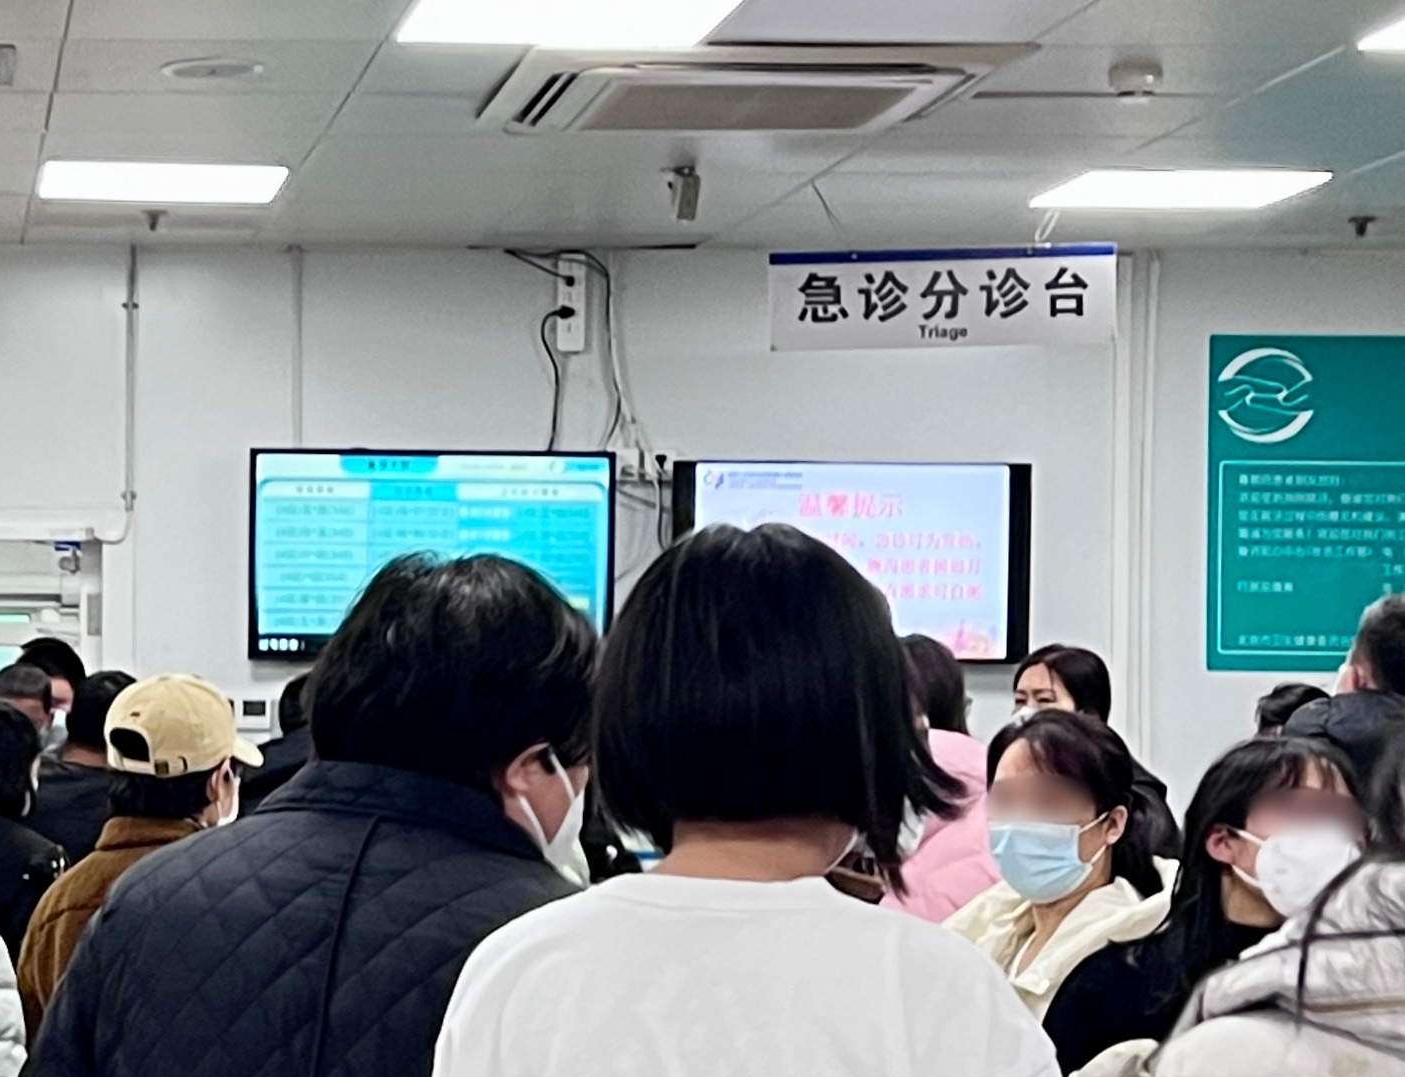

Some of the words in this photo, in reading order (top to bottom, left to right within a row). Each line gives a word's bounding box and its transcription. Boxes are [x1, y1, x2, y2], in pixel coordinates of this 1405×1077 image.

[797, 267, 1090, 324] 急诊分诊台
[918, 323, 969, 342] Triage
